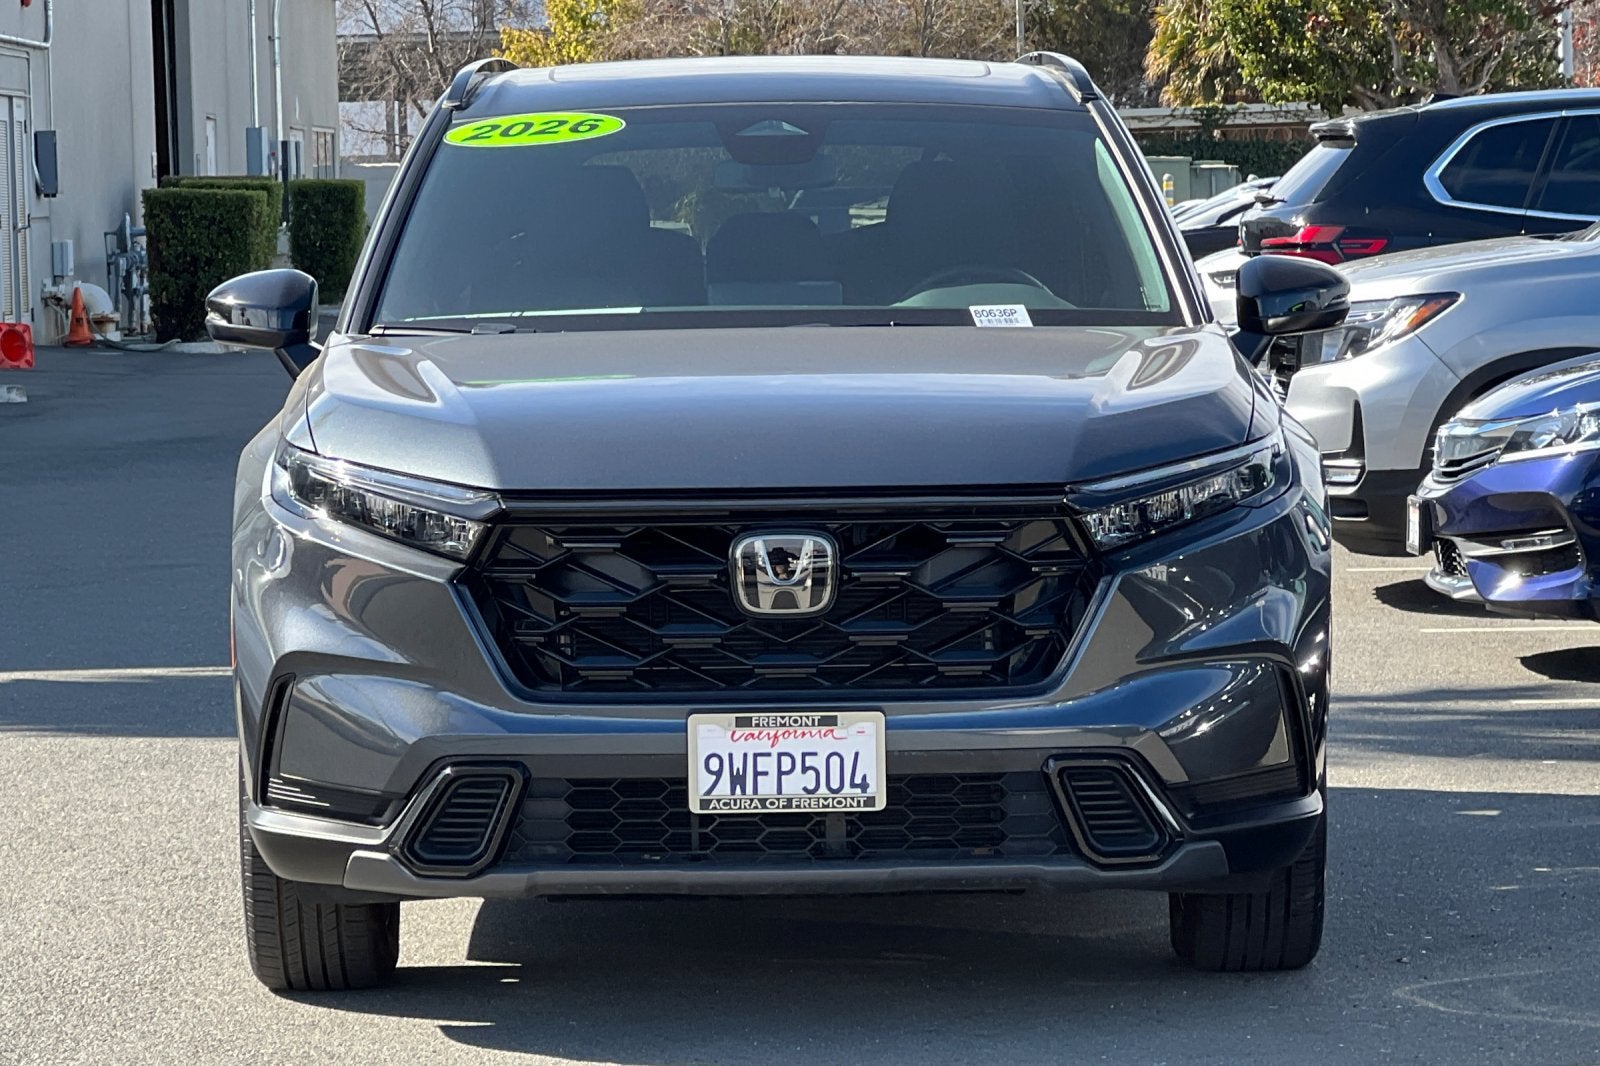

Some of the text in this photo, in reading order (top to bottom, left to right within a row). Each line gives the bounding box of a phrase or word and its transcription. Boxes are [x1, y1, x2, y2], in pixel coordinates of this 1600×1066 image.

[461, 118, 605, 142] 2026
[973, 308, 1017, 319] 80636P
[751, 716, 821, 727] FREMONT
[730, 728, 848, 748] California
[703, 751, 870, 796] 9WFP504
[709, 797, 867, 810] ACURA OF FREMONT
